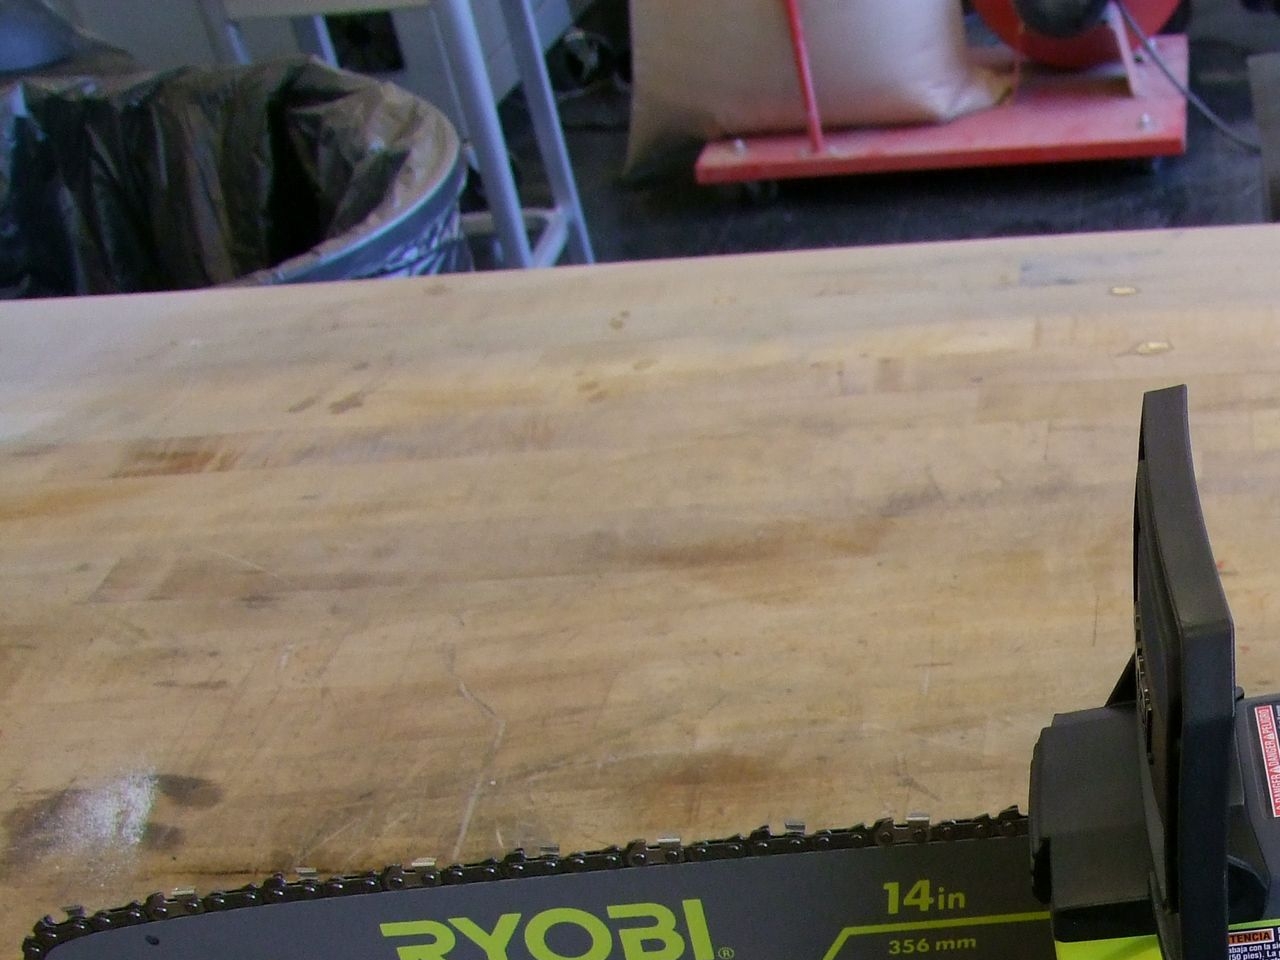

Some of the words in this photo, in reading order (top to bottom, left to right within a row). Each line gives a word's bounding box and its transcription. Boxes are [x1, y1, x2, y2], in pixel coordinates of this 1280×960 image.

[1264, 740, 1279, 766] DANGER
[888, 938, 929, 955] 356
[935, 934, 978, 951] mm
[1228, 931, 1271, 943] TENCIA
[1228, 945, 1247, 954] abaja
